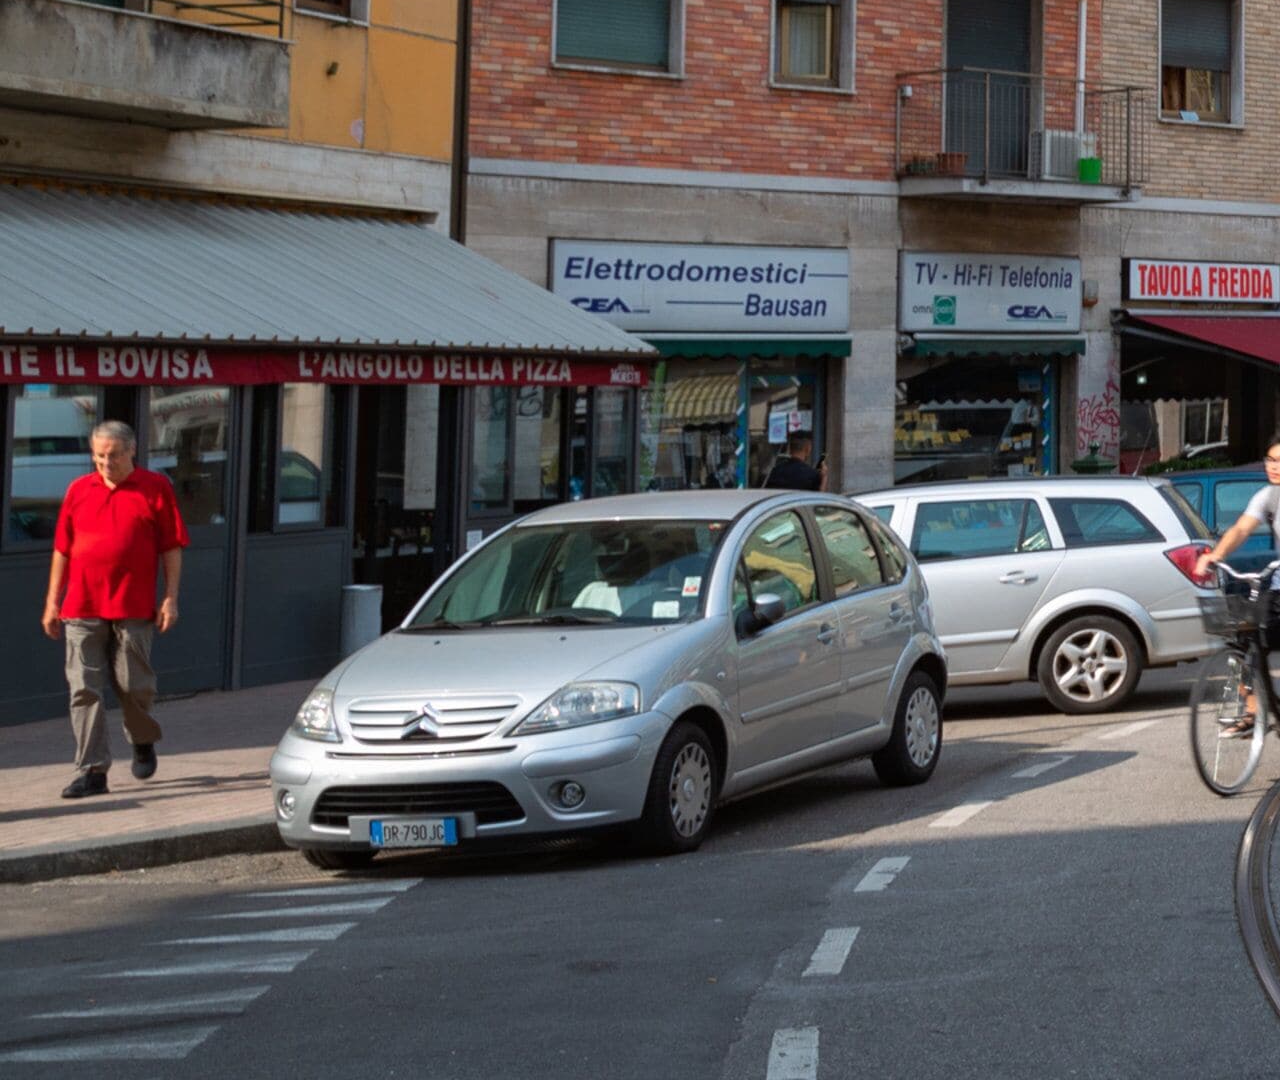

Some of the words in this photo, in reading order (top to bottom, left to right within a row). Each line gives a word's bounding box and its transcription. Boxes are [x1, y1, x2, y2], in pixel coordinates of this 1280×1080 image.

[564, 257, 808, 285] Elettrodomestici
[915, 262, 938, 285] TV
[953, 264, 993, 287] Hi-Fi
[1000, 265, 1073, 289] Telefonia
[1138, 264, 1202, 297] TAVOLA
[1209, 266, 1273, 299] FREDDA
[744, 293, 827, 318] Bausan
[1007, 304, 1053, 319] CEA
[55, 346, 85, 377] IL
[97, 347, 214, 380] BOVISA
[299, 351, 424, 380] L'ANGOLO
[433, 355, 505, 381] DELLA
[512, 357, 572, 383] PIZZA
